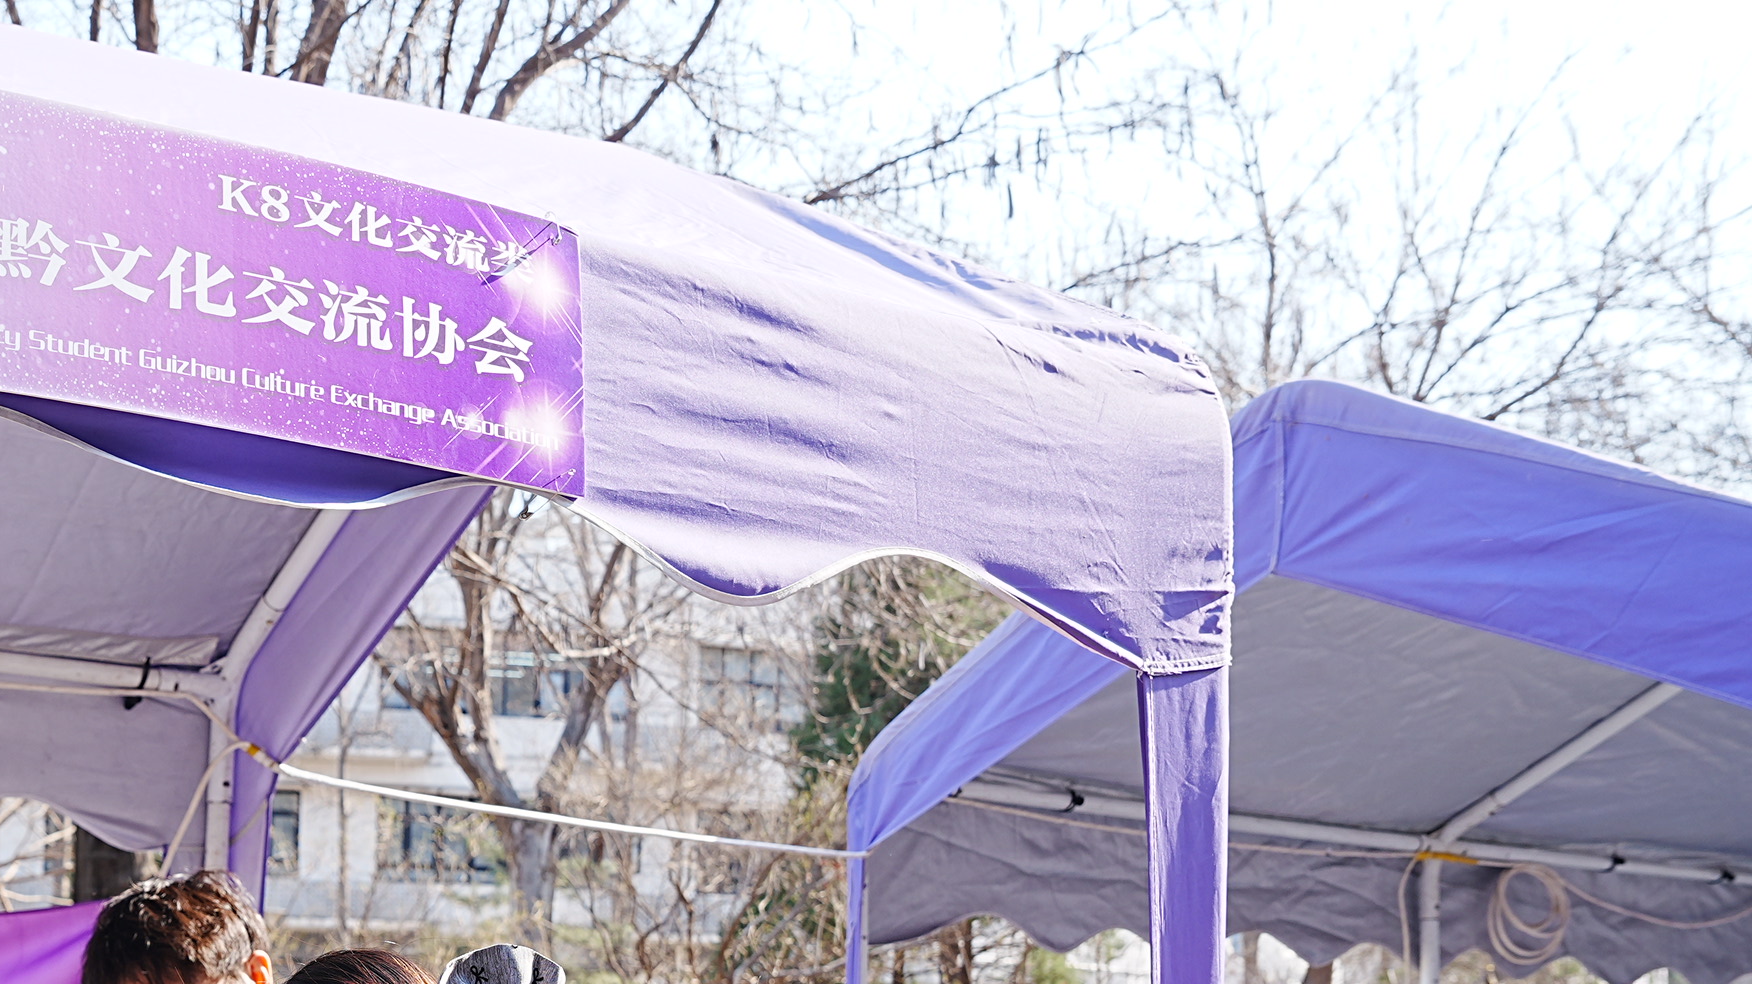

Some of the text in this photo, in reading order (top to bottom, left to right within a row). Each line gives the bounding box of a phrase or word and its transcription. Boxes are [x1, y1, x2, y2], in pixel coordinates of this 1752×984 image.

[216, 173, 536, 284] K8文化交流类
[28, 329, 133, 367] Student
[138, 348, 236, 385] Guizhou
[241, 367, 325, 402] Culture
[330, 384, 436, 425] Exchange
[440, 408, 559, 450] Association
